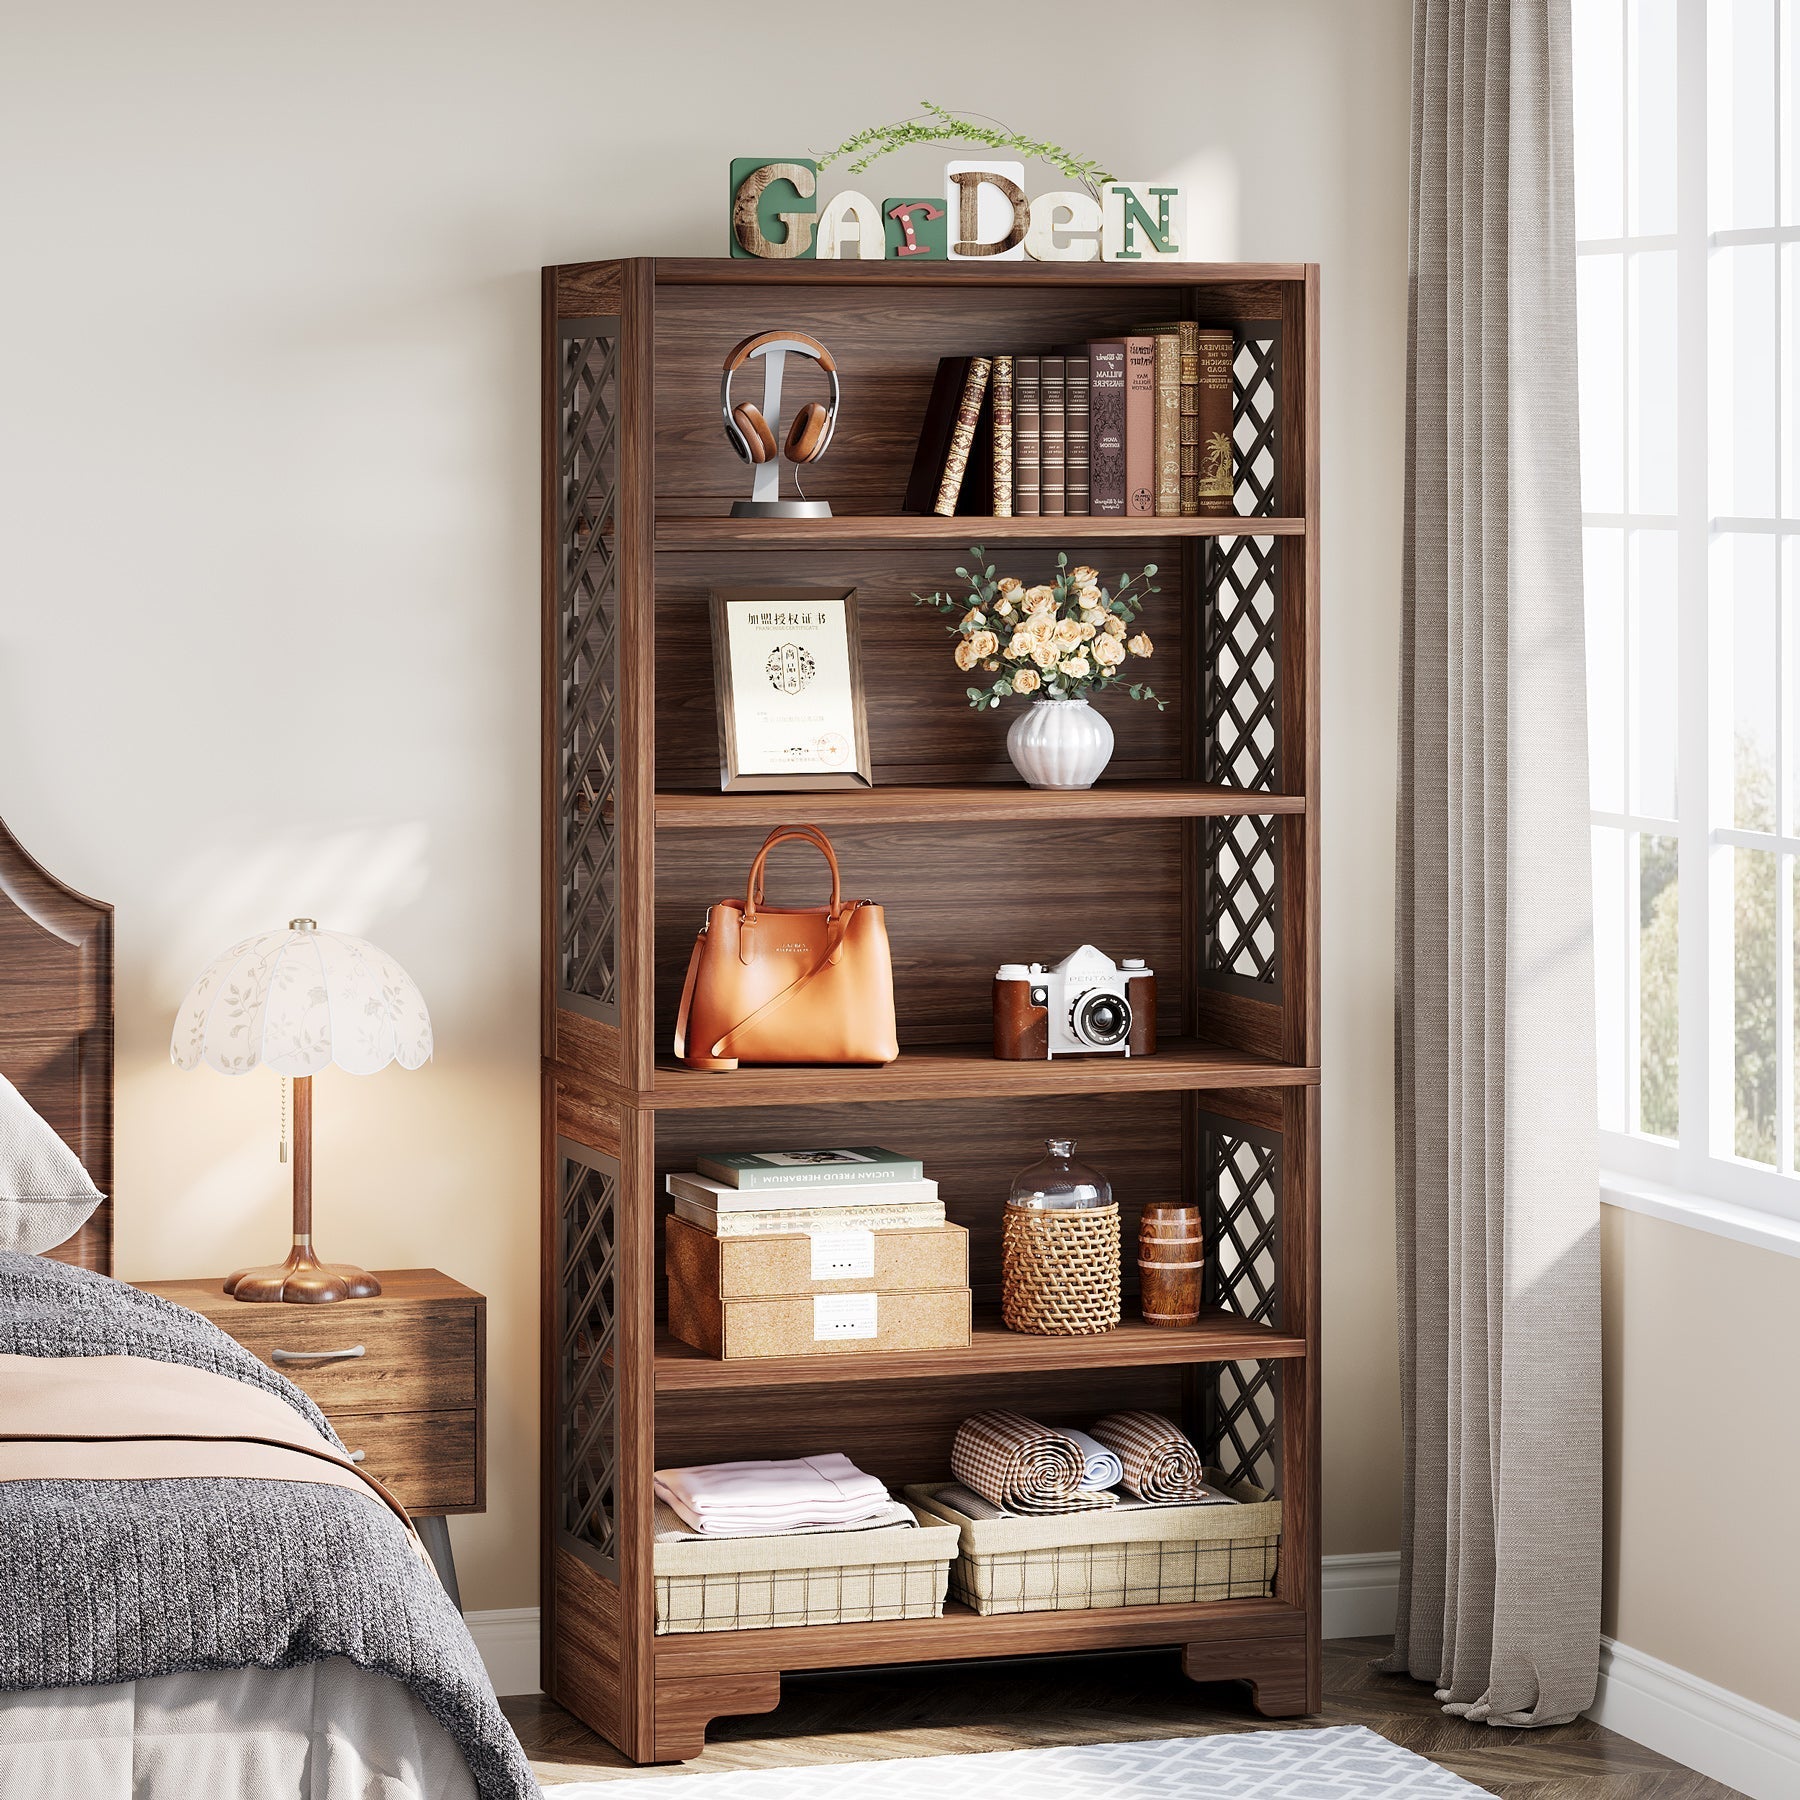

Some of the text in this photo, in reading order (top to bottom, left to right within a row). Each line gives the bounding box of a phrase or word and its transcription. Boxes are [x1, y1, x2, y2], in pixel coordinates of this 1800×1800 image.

[748, 612, 826, 625] 加盟授权证书
[763, 1174, 821, 1183] HERBARIUM
[823, 1172, 855, 1180] FREUD
[857, 1171, 895, 1179] LUCIAN
